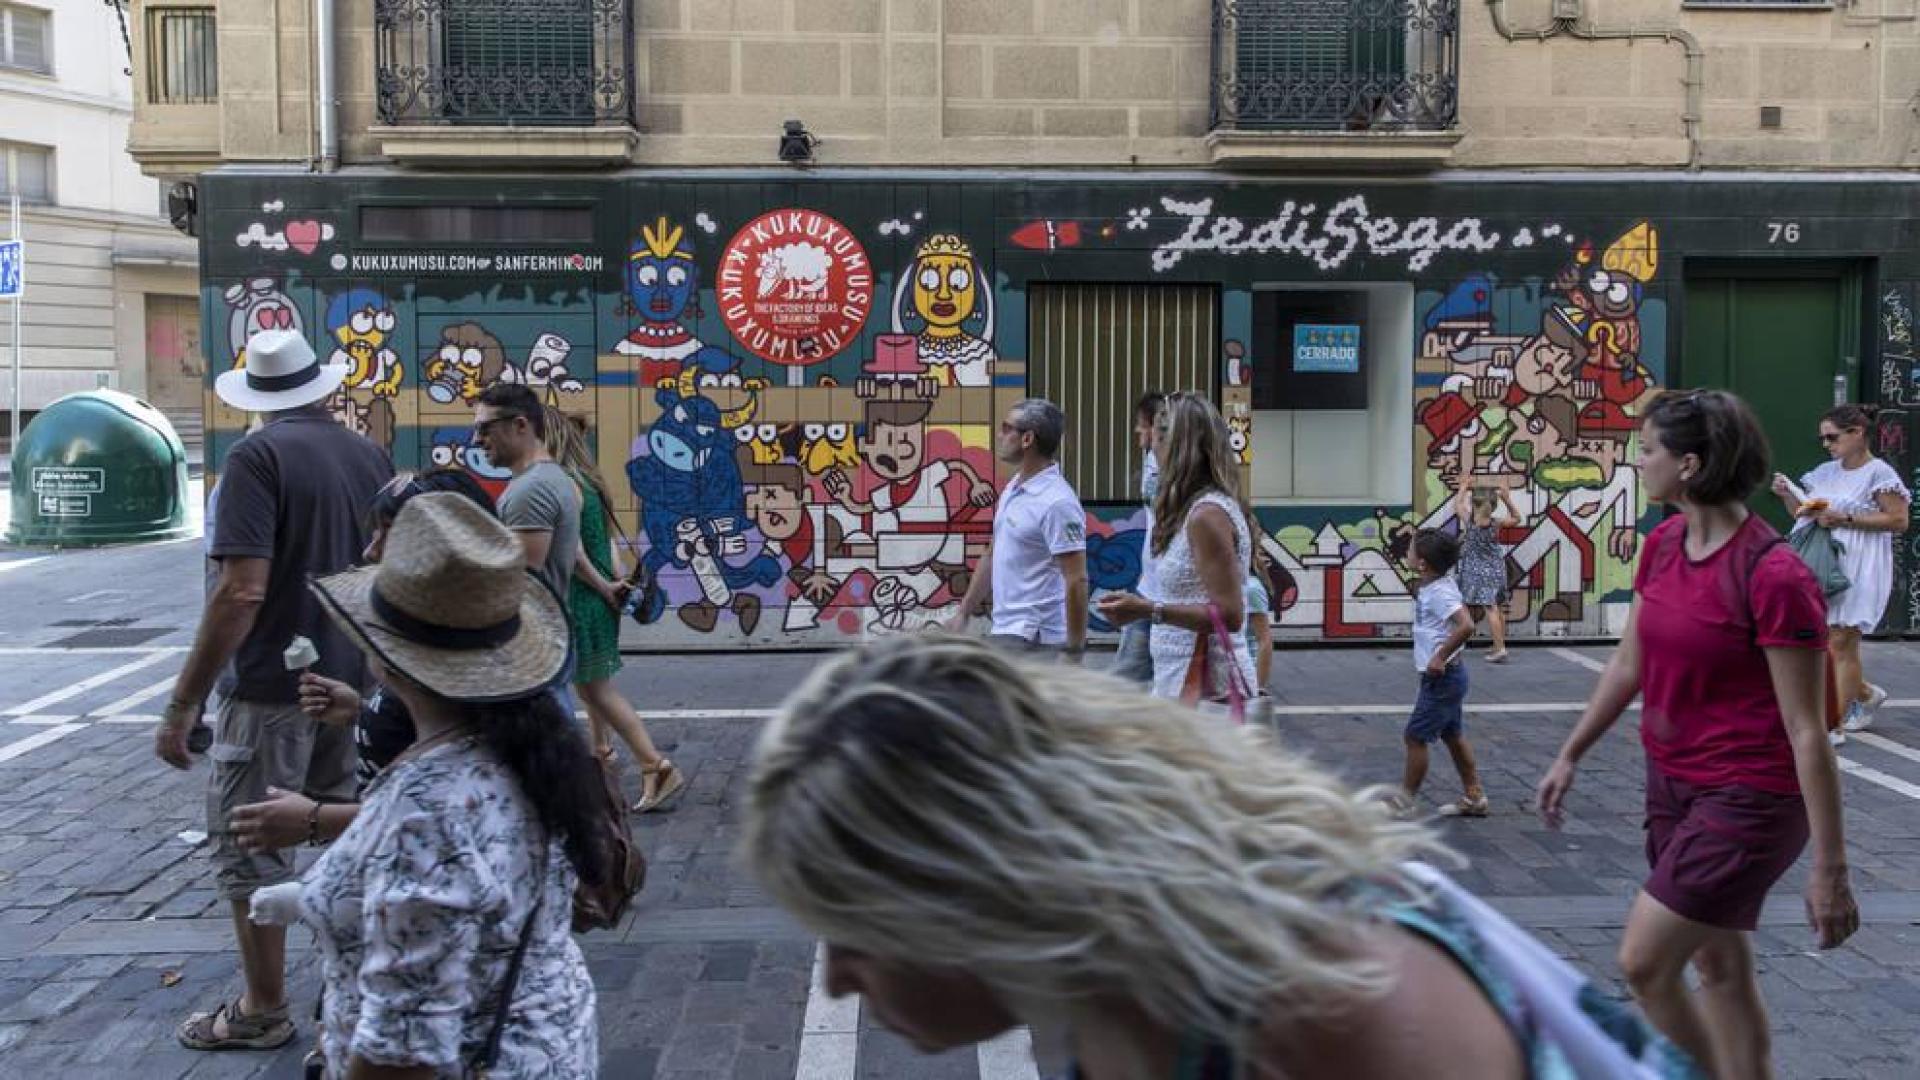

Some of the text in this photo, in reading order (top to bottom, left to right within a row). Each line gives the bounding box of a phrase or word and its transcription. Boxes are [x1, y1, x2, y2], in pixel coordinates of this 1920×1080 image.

[1767, 222, 1801, 244] 76
[352, 255, 477, 271] KUKUXUMUSU.COM
[495, 255, 603, 271] SANFERMINOM
[751, 212, 870, 322] KUKUXUMUSU
[1296, 345, 1356, 360] CERRADO
